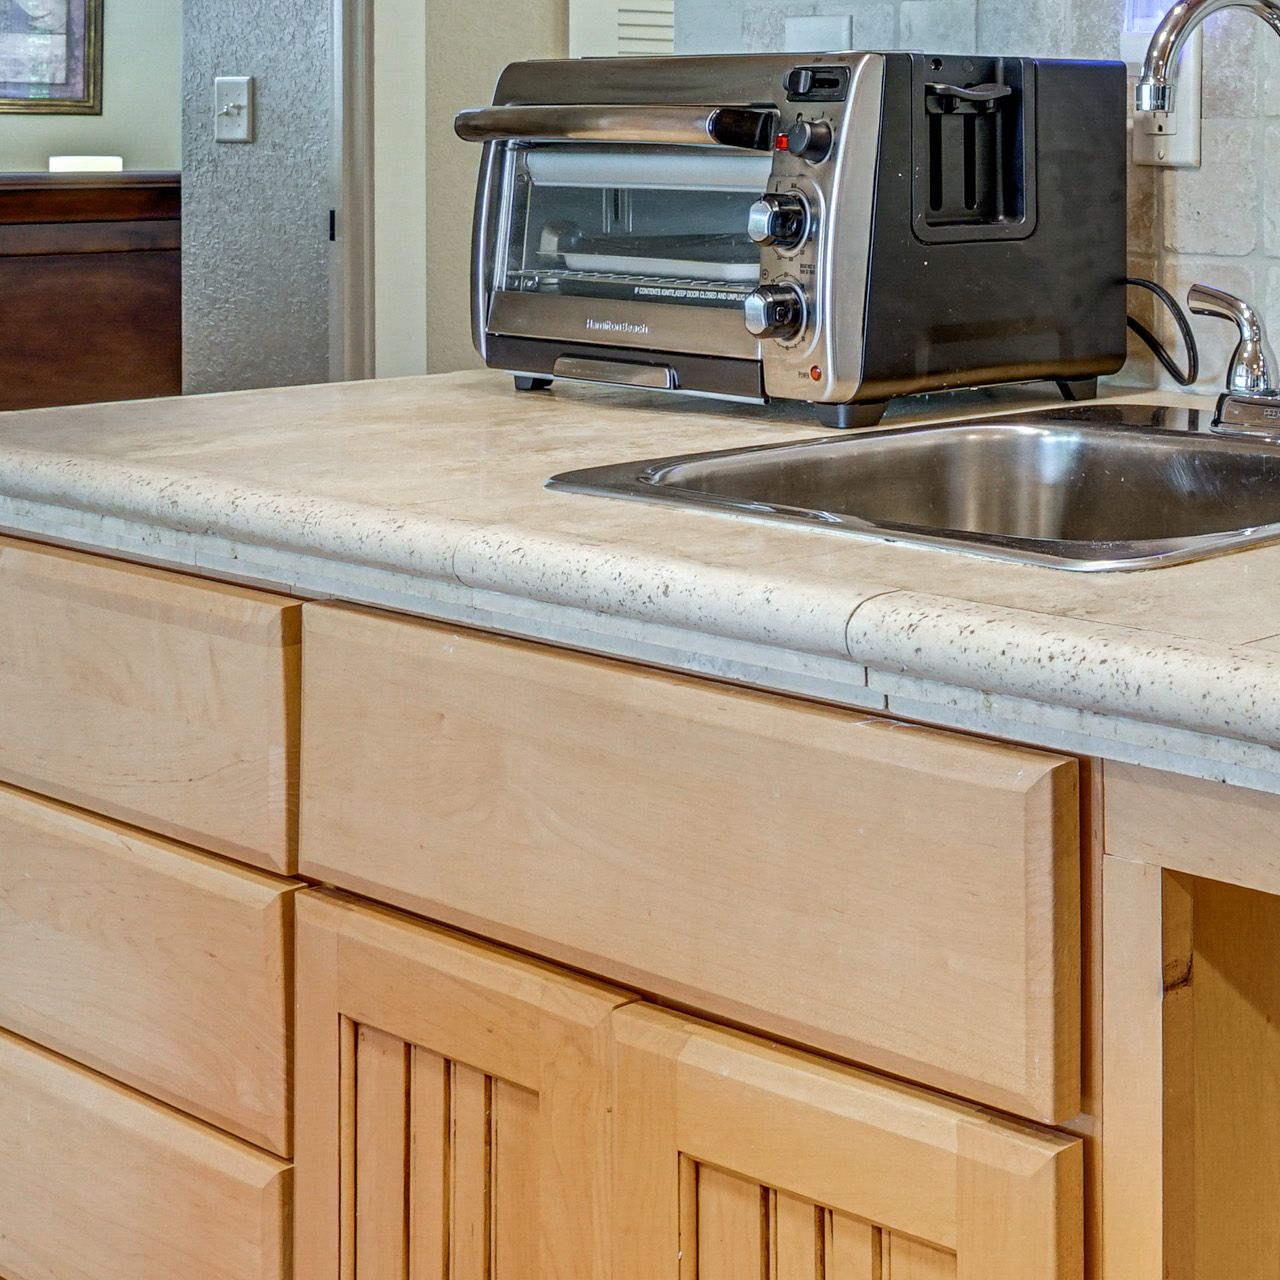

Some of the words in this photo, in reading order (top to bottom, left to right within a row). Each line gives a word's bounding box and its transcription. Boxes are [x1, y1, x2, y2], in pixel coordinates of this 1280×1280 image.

[686, 290, 699, 298] DOOR
[700, 290, 717, 299] CLOSED
[717, 291, 727, 300] AND
[727, 292, 745, 301] UNPLUG
